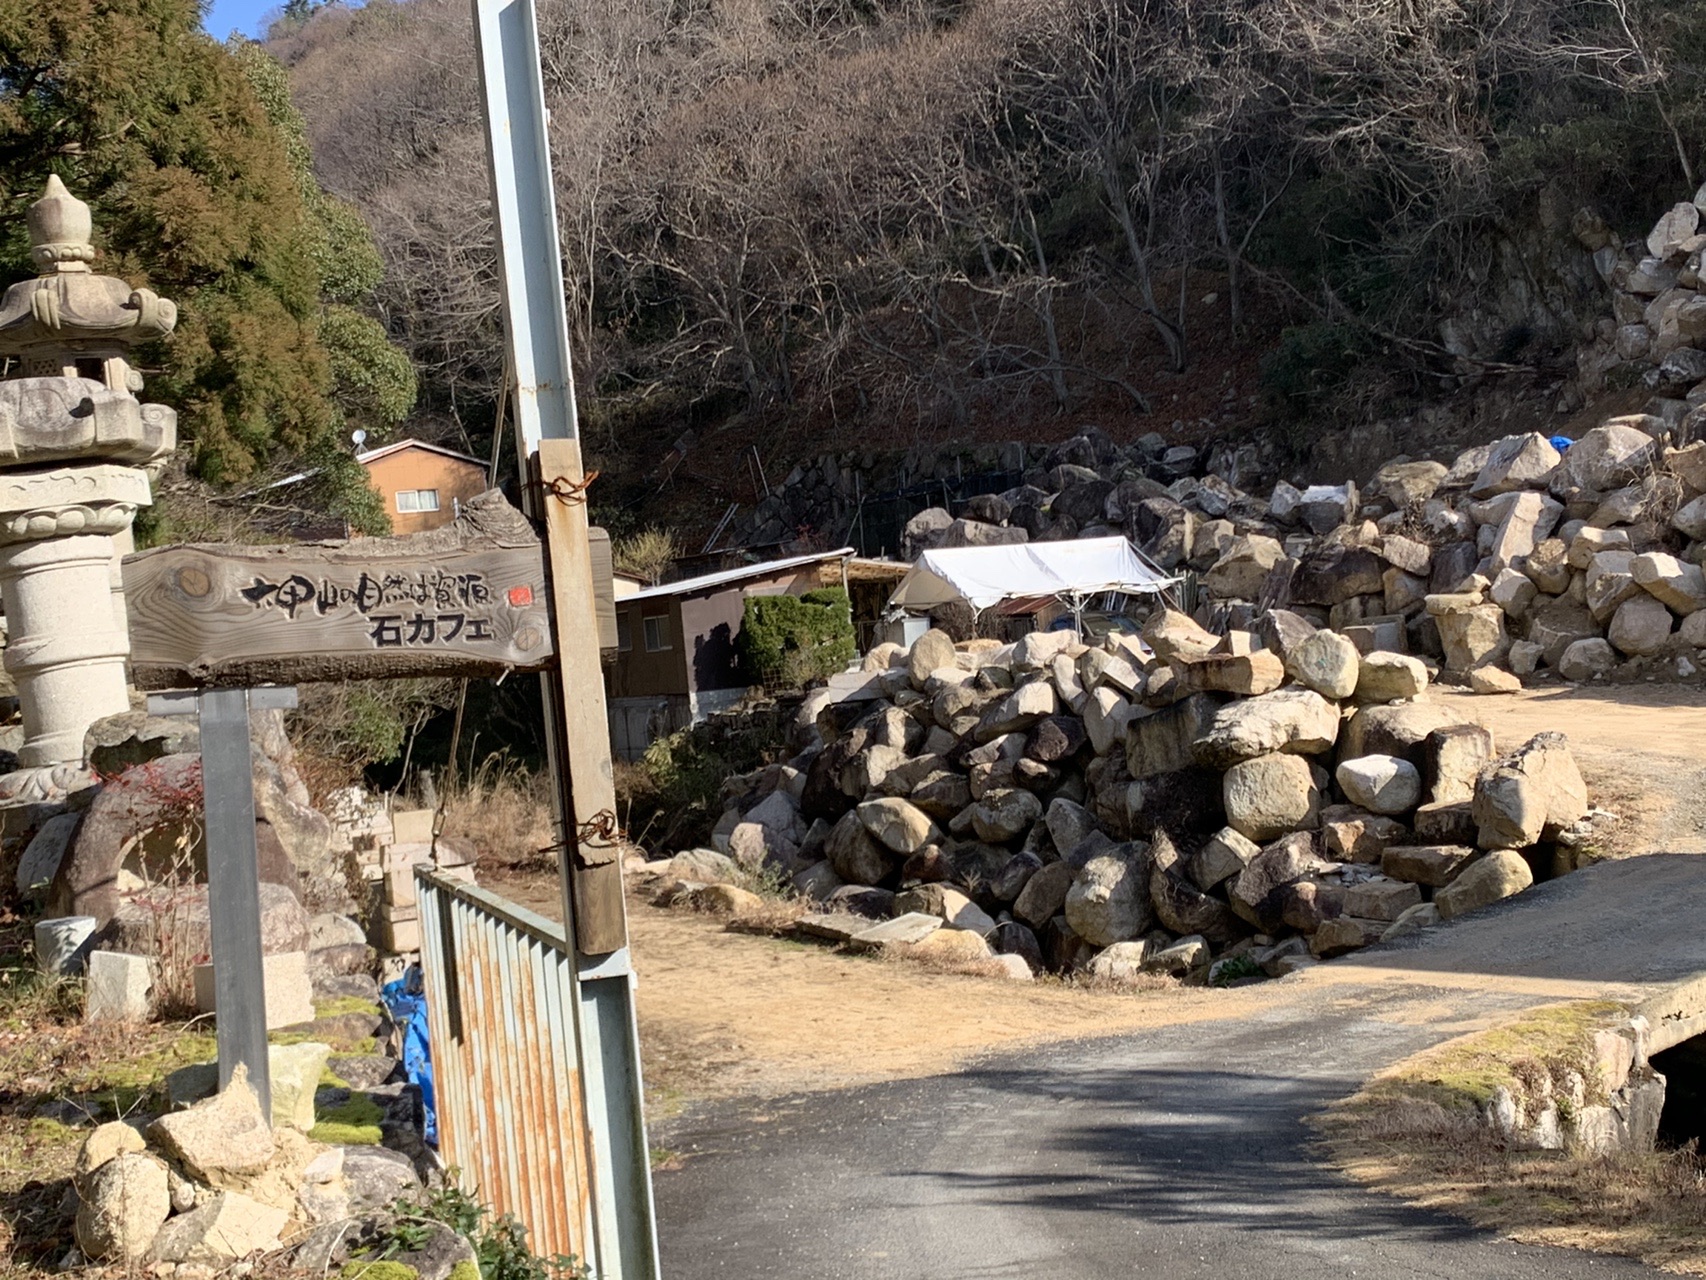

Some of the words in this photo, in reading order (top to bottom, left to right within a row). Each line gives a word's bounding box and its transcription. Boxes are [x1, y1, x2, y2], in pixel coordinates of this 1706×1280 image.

[241, 572, 492, 619] 六甲山の自然は資源
[369, 613, 494, 647] 石カフェ
